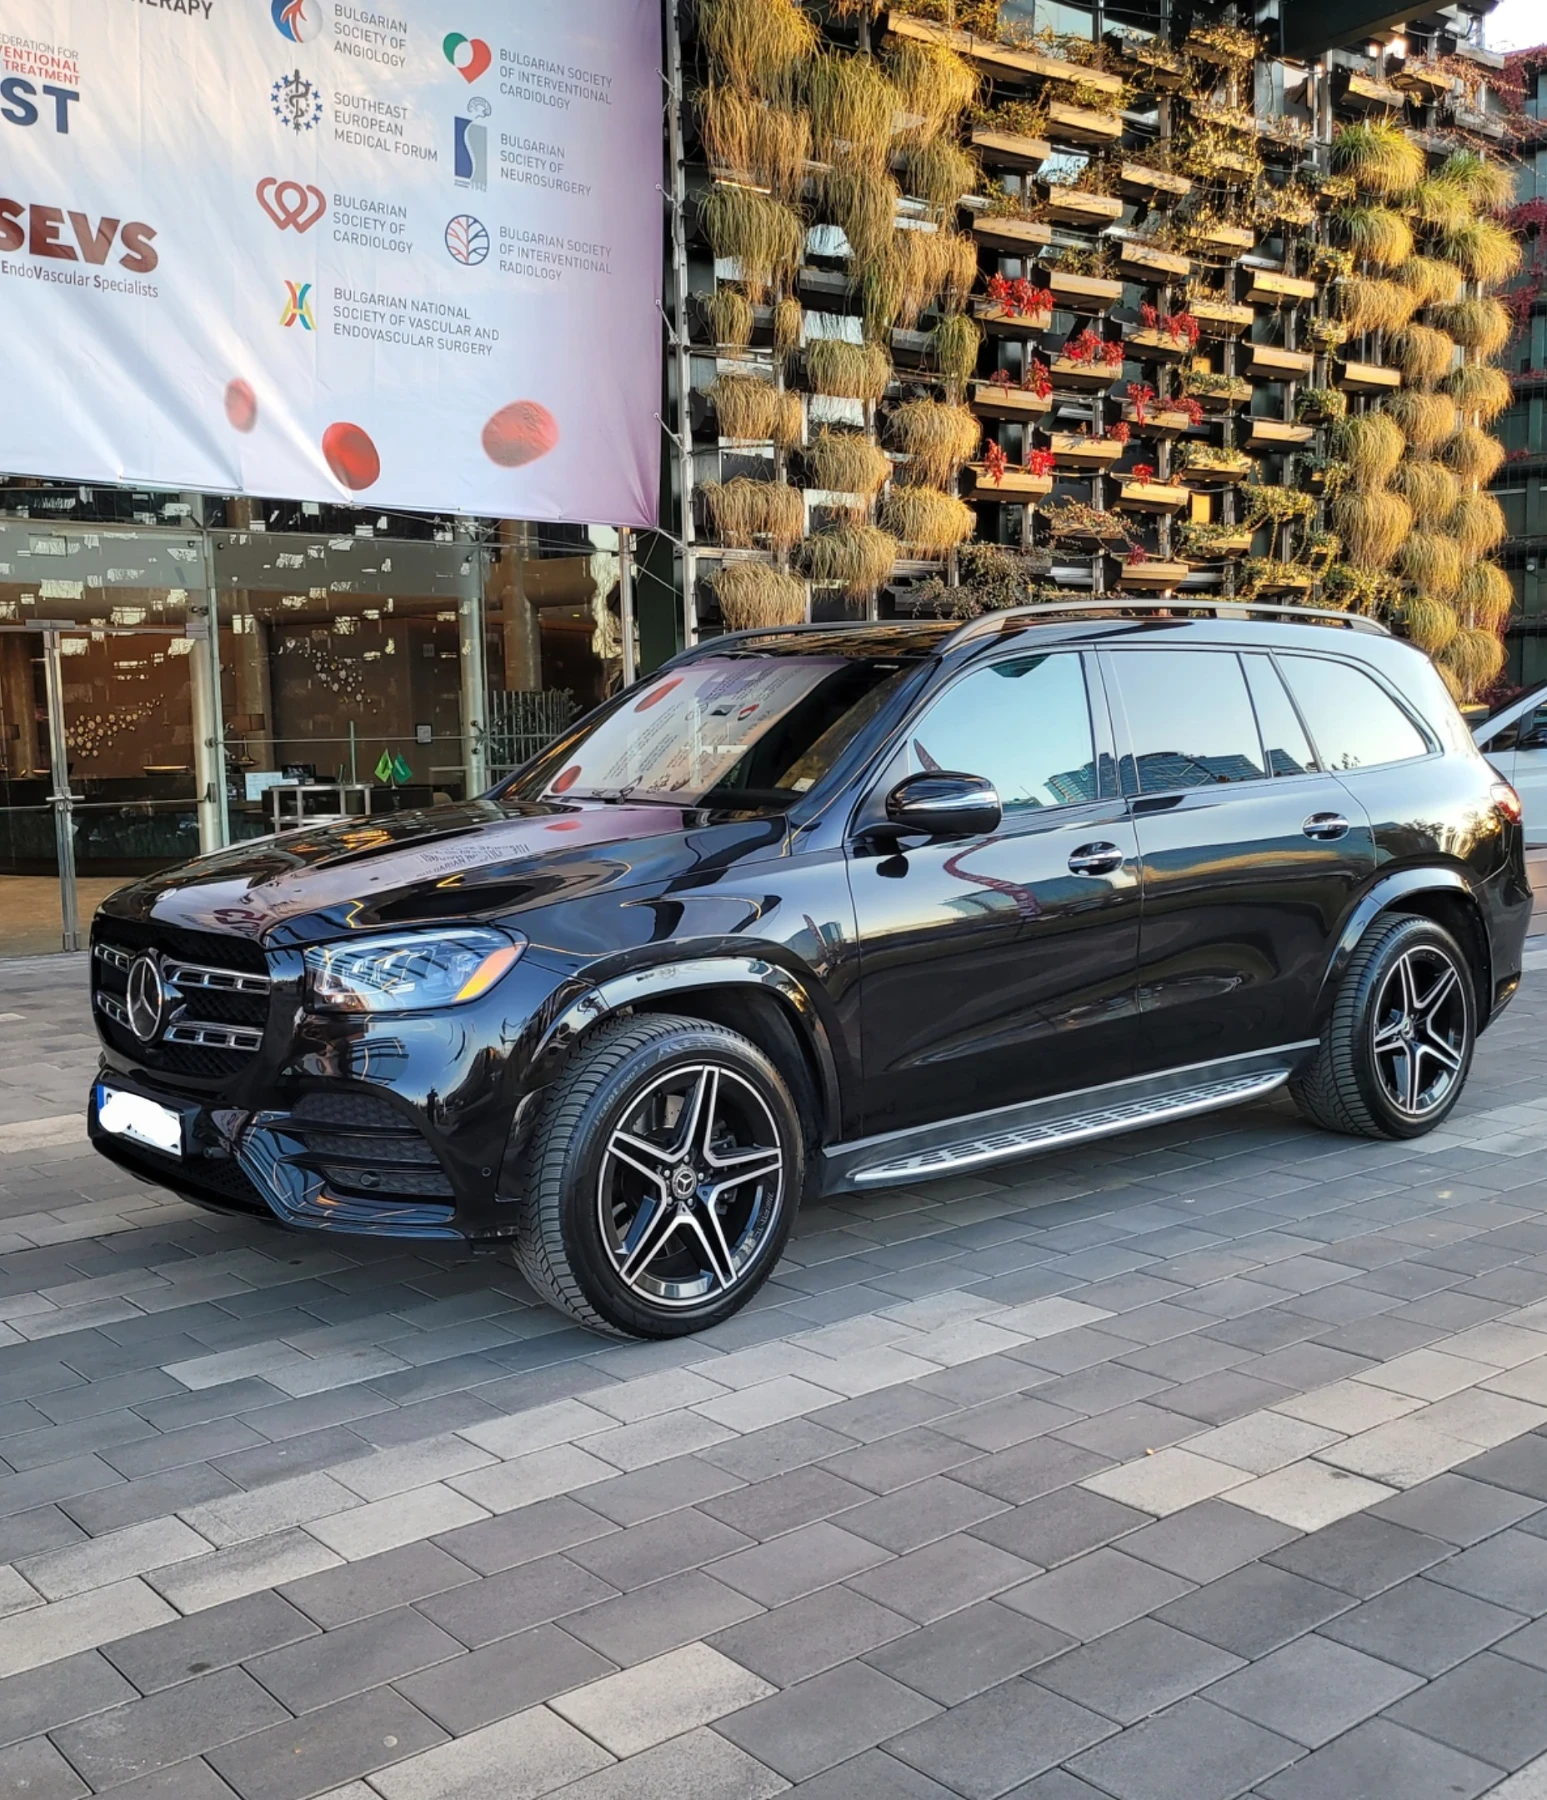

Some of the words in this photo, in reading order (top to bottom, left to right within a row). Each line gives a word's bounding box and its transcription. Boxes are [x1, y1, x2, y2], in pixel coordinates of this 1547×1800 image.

[334, 3, 407, 34] BULGARIAN
[0, 32, 55, 55] DERATION
[57, 46, 79, 60] FOR
[333, 21, 387, 46] SOCIETY
[389, 37, 407, 51] OF
[333, 40, 406, 68] ANGIOLOGY
[500, 48, 565, 76] BULGARIAN
[567, 66, 613, 89] SOCIETY
[3, 59, 81, 86] TREATMENT
[500, 65, 516, 79] OF
[518, 69, 613, 105] INTERVENTIONAL
[333, 91, 408, 120] SOUTHEAST
[500, 82, 571, 111] CARDIOLOGY
[334, 110, 404, 137] EUROPEAN
[334, 127, 391, 152] MEDICAL
[394, 140, 439, 163] FORUM
[500, 132, 566, 160] BULGARIAN
[500, 149, 547, 171] SOCIETY
[549, 160, 565, 174] OF
[500, 165, 593, 197] NEUROSURGERY
[333, 193, 408, 220] BULGARIAN
[333, 211, 387, 232] SOCIETY
[389, 221, 406, 235] OF
[333, 229, 414, 255] CARDIOLOGY
[499, 225, 565, 250] BULGARIAN
[566, 239, 613, 259] SOCIETY
[499, 242, 516, 256] OF
[517, 246, 613, 276] INTERVENTIONAL
[499, 259, 563, 282] RADIOLOGY
[1, 259, 91, 287] EndoVascular
[93, 274, 159, 298] Specialists
[333, 286, 408, 311] BULGARIAN
[410, 299, 472, 320] NATIONAL
[333, 305, 387, 325] SOCIETY
[389, 313, 406, 327] OF
[408, 316, 472, 337] VASCULAR
[474, 326, 501, 342] AND
[333, 322, 435, 349] ENDOVASCULAR
[437, 338, 494, 357] SURGERY
